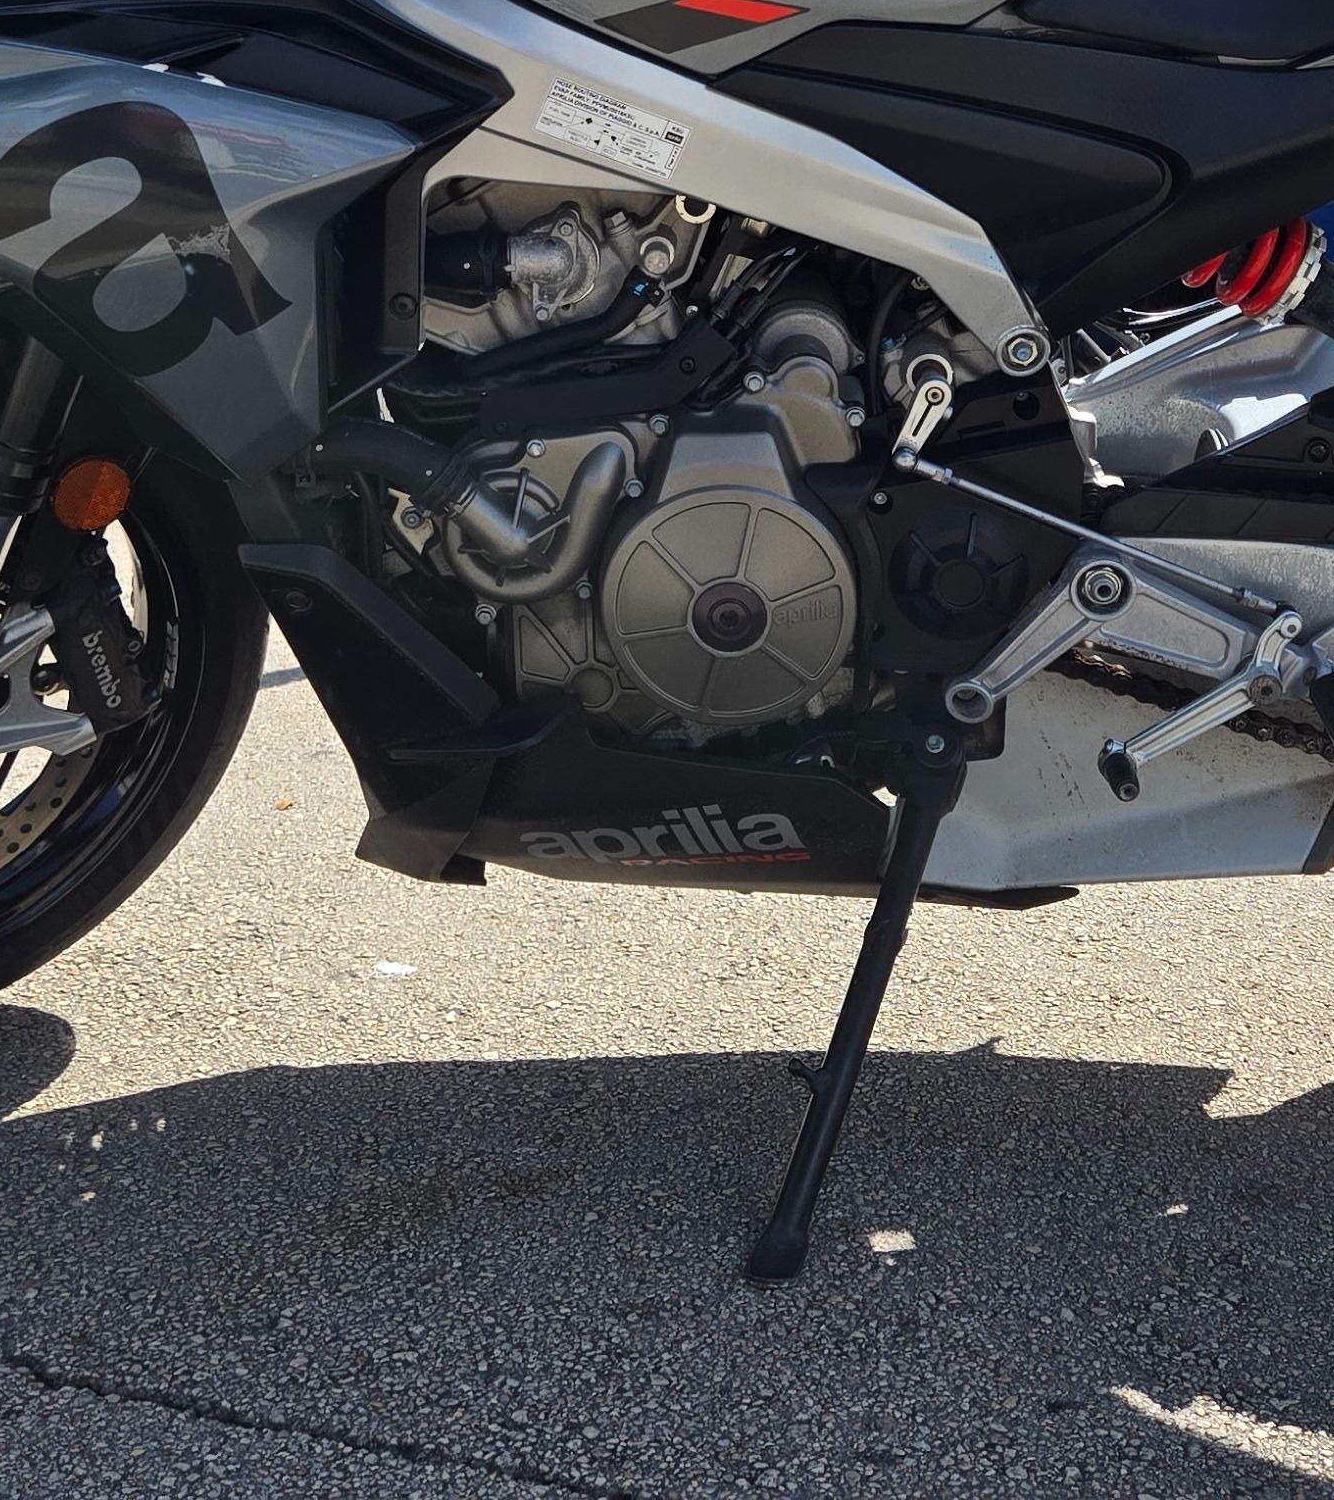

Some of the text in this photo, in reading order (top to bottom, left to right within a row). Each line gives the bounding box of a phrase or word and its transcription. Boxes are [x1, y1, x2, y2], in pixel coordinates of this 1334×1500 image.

[773, 599, 837, 627] aprilia
[81, 629, 122, 709] brembo
[520, 804, 808, 864] aprilia
